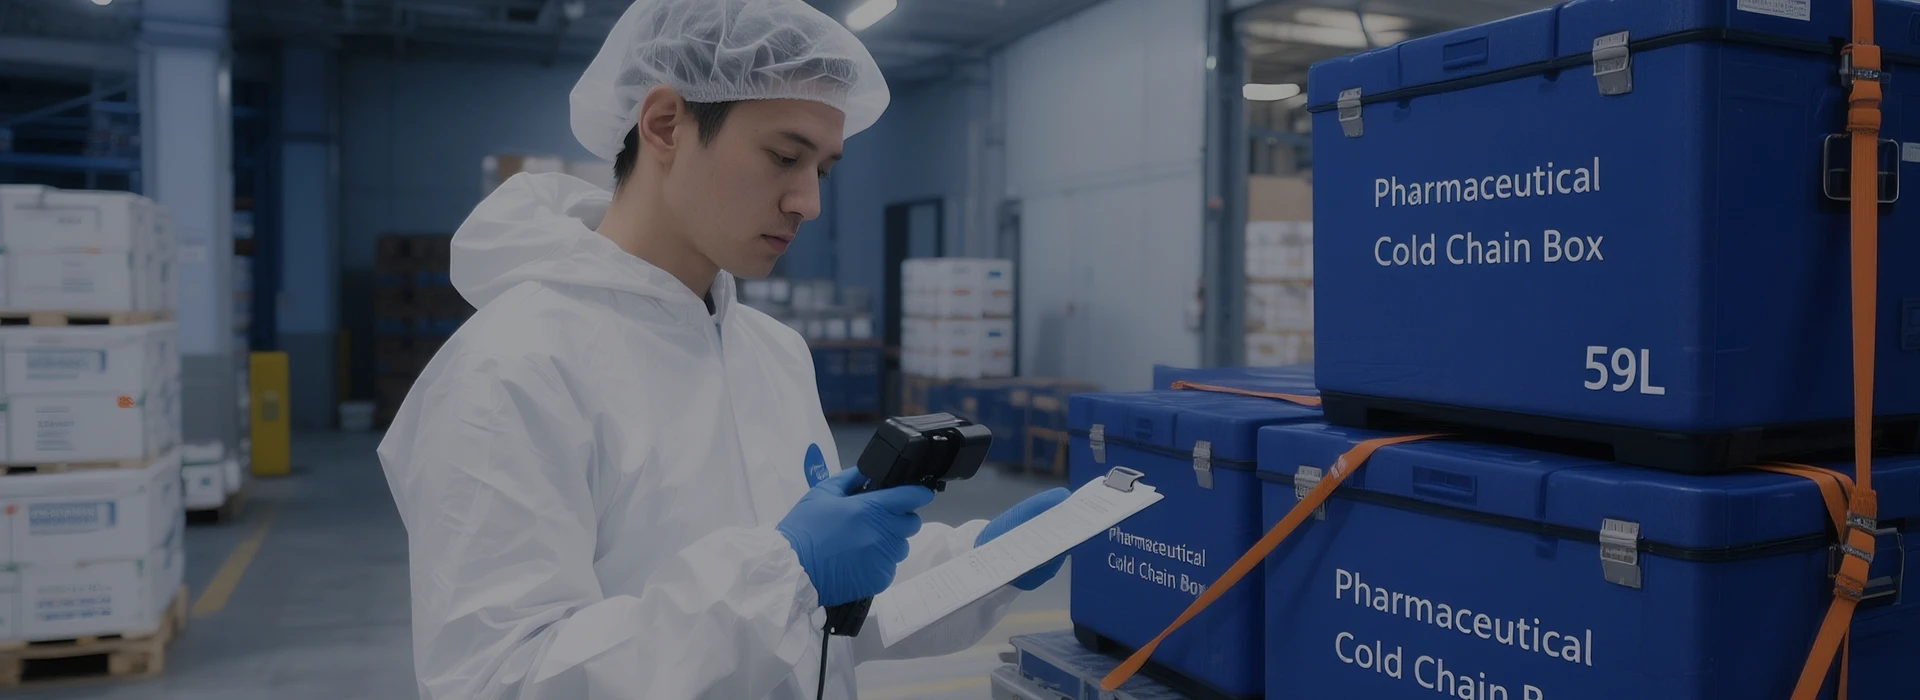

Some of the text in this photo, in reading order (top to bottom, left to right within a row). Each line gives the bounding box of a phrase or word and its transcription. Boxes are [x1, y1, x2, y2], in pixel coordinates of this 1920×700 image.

[1374, 157, 1601, 208] Pharmaceutical
[1374, 229, 1604, 266] Cold Chain Box
[1583, 346, 1666, 395] 59L
[1107, 552, 1135, 575] Cold
[1139, 561, 1176, 589] Chain
[1108, 526, 1206, 567] Pharmaceutical
[1335, 568, 1593, 666] Pharmaceutical
[1335, 631, 1509, 700] Cold Chain
